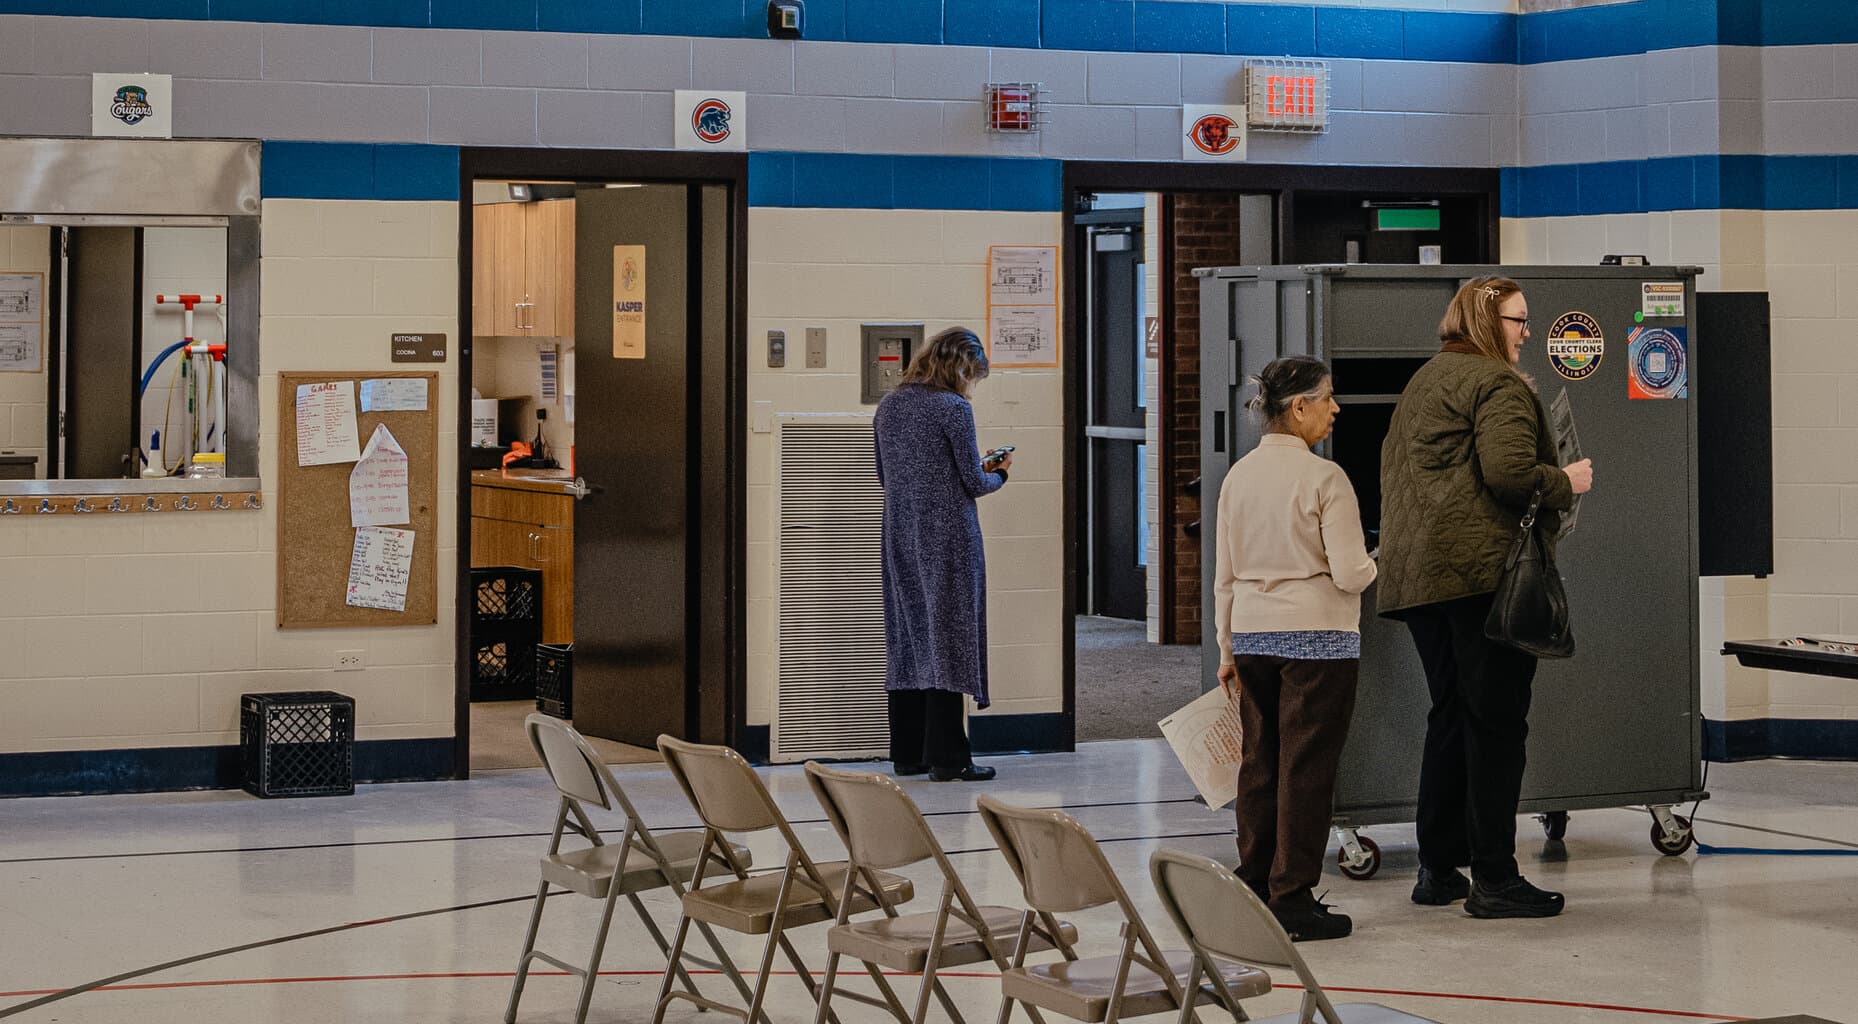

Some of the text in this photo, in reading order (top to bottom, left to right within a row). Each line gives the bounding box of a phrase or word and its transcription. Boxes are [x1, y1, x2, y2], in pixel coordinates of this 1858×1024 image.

[1266, 76, 1316, 116] EXIT
[111, 103, 152, 121] Cougars
[616, 301, 643, 313] KASPER
[1552, 314, 1600, 337] COOK COUNTY
[1550, 345, 1602, 354] ELECTIONS
[1558, 364, 1594, 377] ILLINOIS
[311, 383, 337, 393] GAMES
